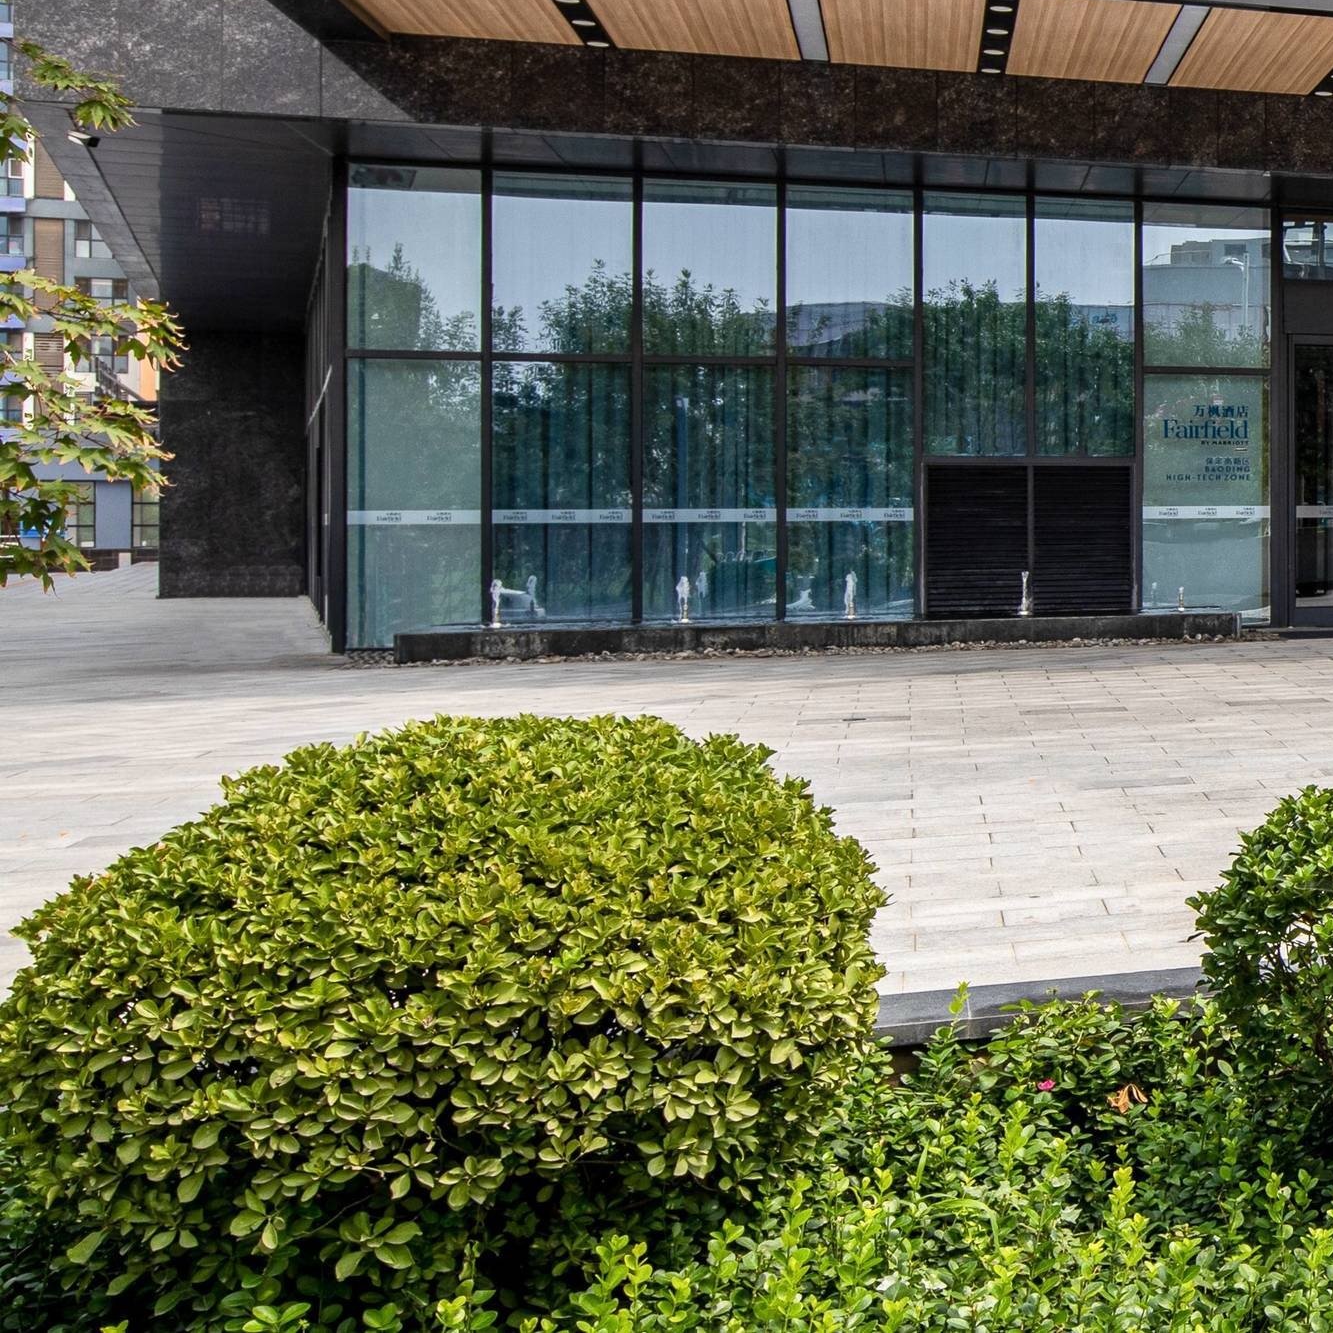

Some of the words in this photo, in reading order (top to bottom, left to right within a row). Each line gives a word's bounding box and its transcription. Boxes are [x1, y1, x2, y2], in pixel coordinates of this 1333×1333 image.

[1193, 405, 1248, 418] 万枫酒店
[1163, 419, 1249, 439] Fairfield
[1166, 473, 1222, 481] HIGH-TECH
[1223, 473, 1251, 481] ZONE
